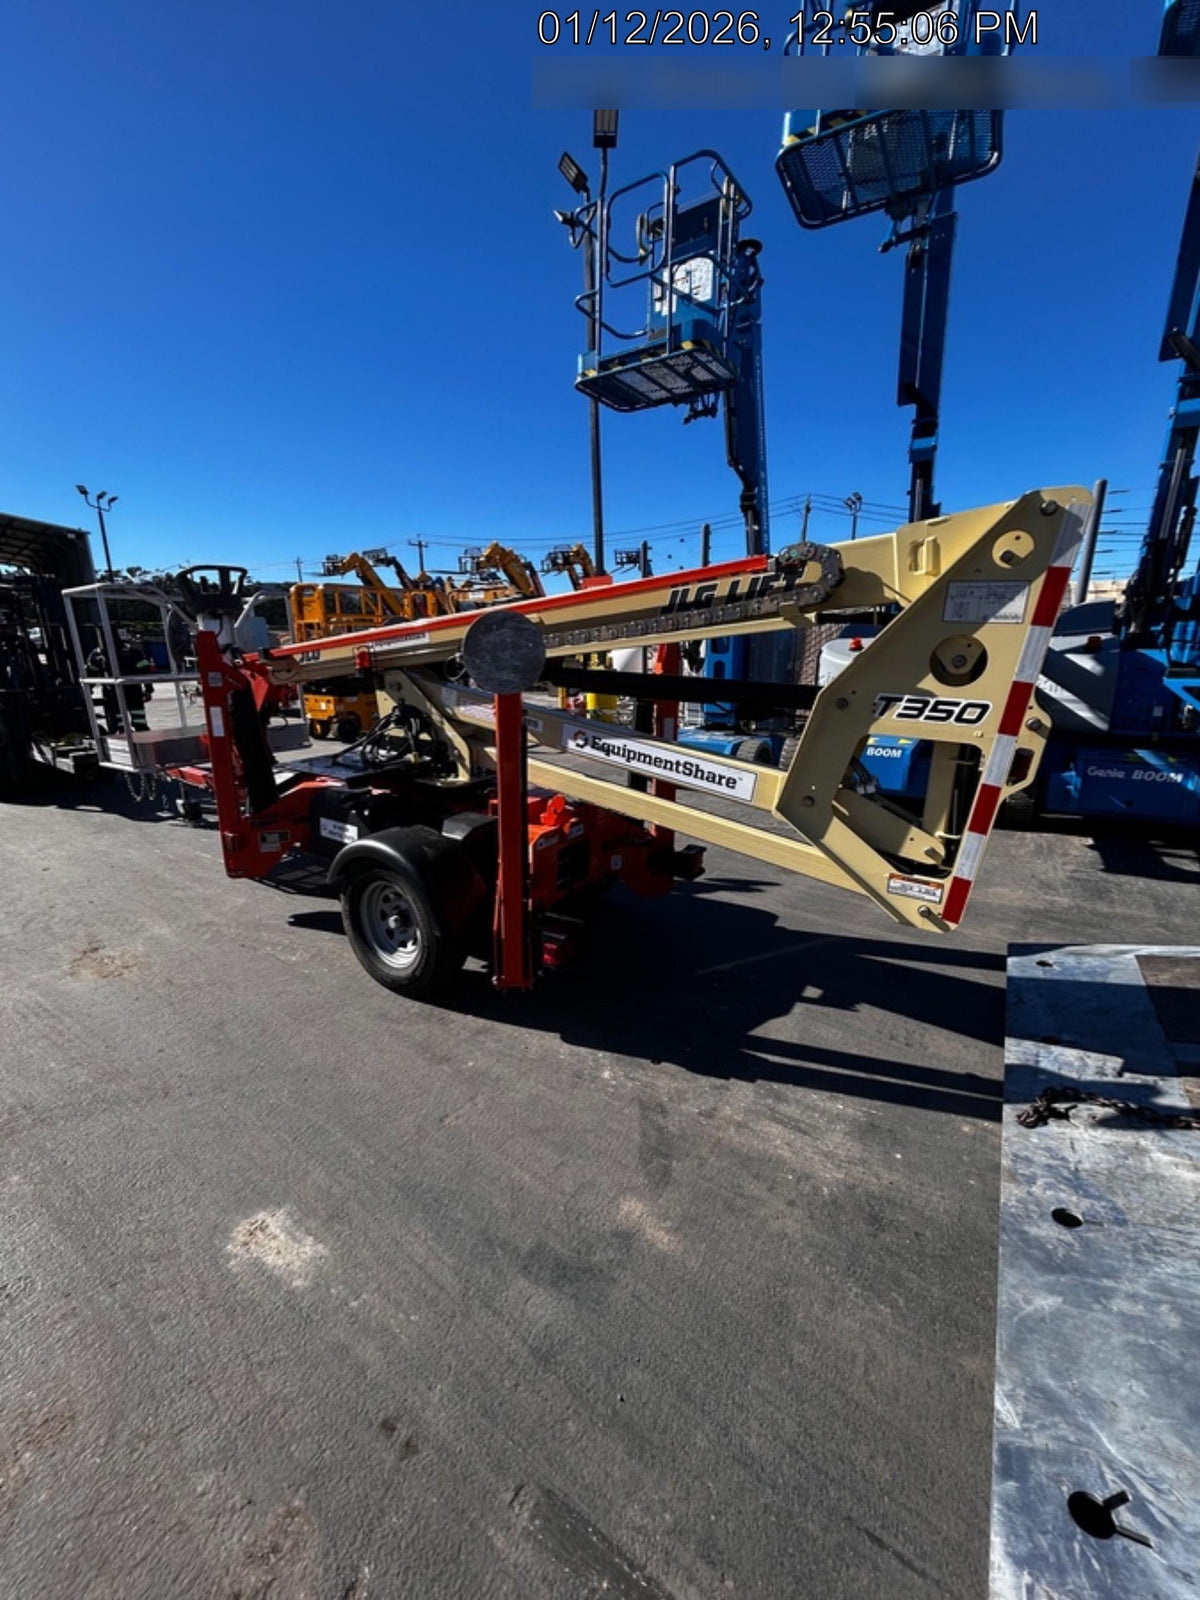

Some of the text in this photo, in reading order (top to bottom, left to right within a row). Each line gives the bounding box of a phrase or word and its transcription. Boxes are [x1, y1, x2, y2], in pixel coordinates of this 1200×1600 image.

[660, 582, 718, 614] JLG
[876, 694, 992, 725] T350
[591, 734, 738, 790] EquipmentShare
[866, 746, 902, 759] BOOM
[1087, 765, 1184, 783] Genie BOOM
